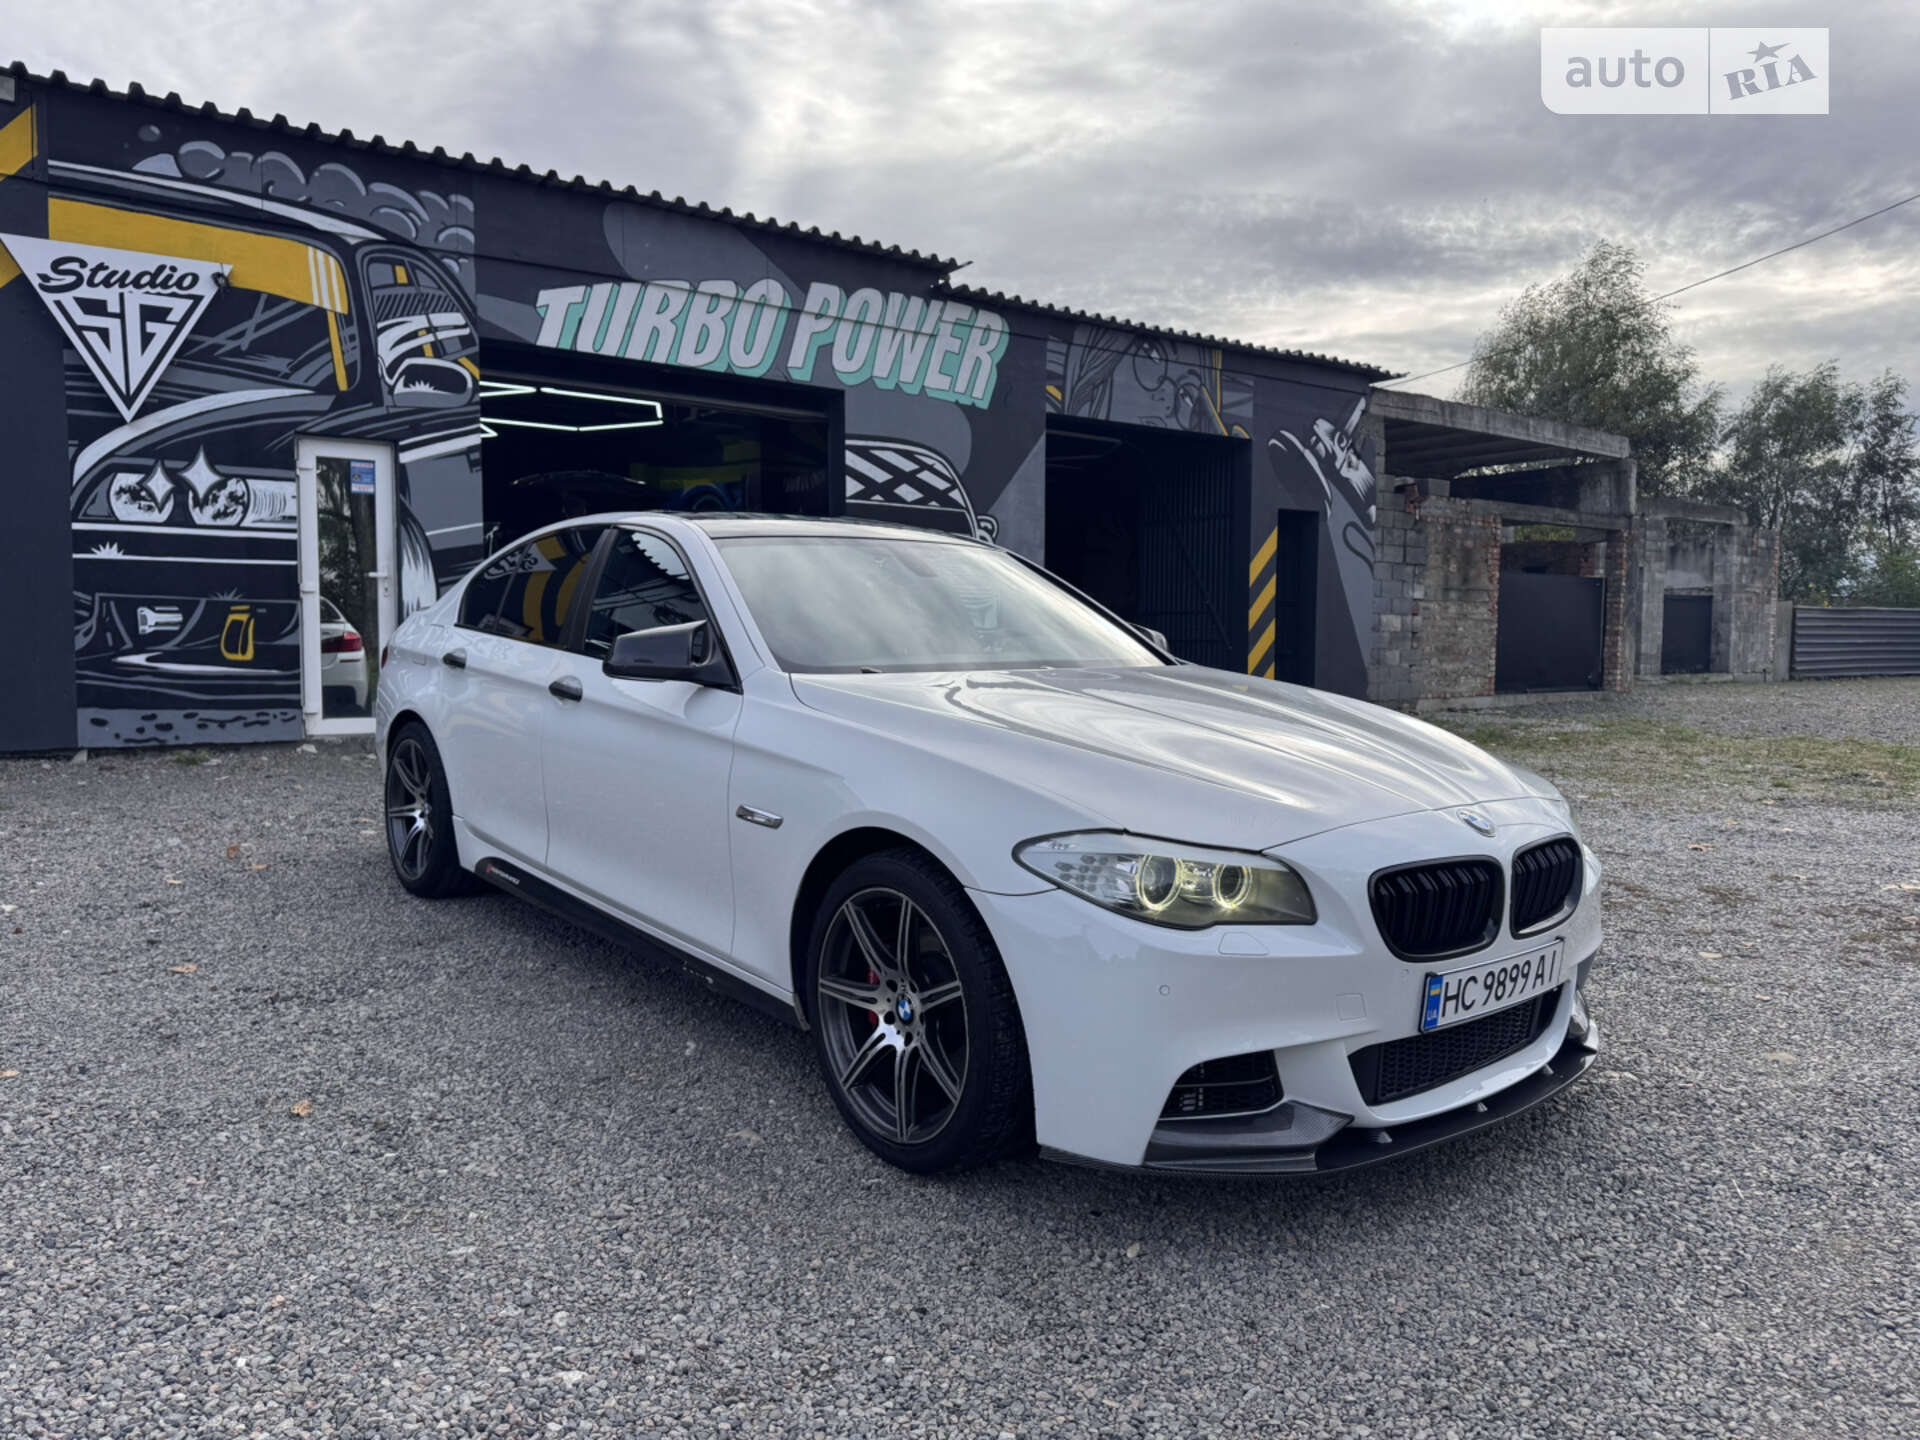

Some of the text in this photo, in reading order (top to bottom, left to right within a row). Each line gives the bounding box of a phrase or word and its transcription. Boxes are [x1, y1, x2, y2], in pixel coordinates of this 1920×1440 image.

[37, 255, 199, 294] Studio
[535, 278, 1010, 410] TURBO POWER
[1442, 950, 1557, 1017] HC 9899 AI
